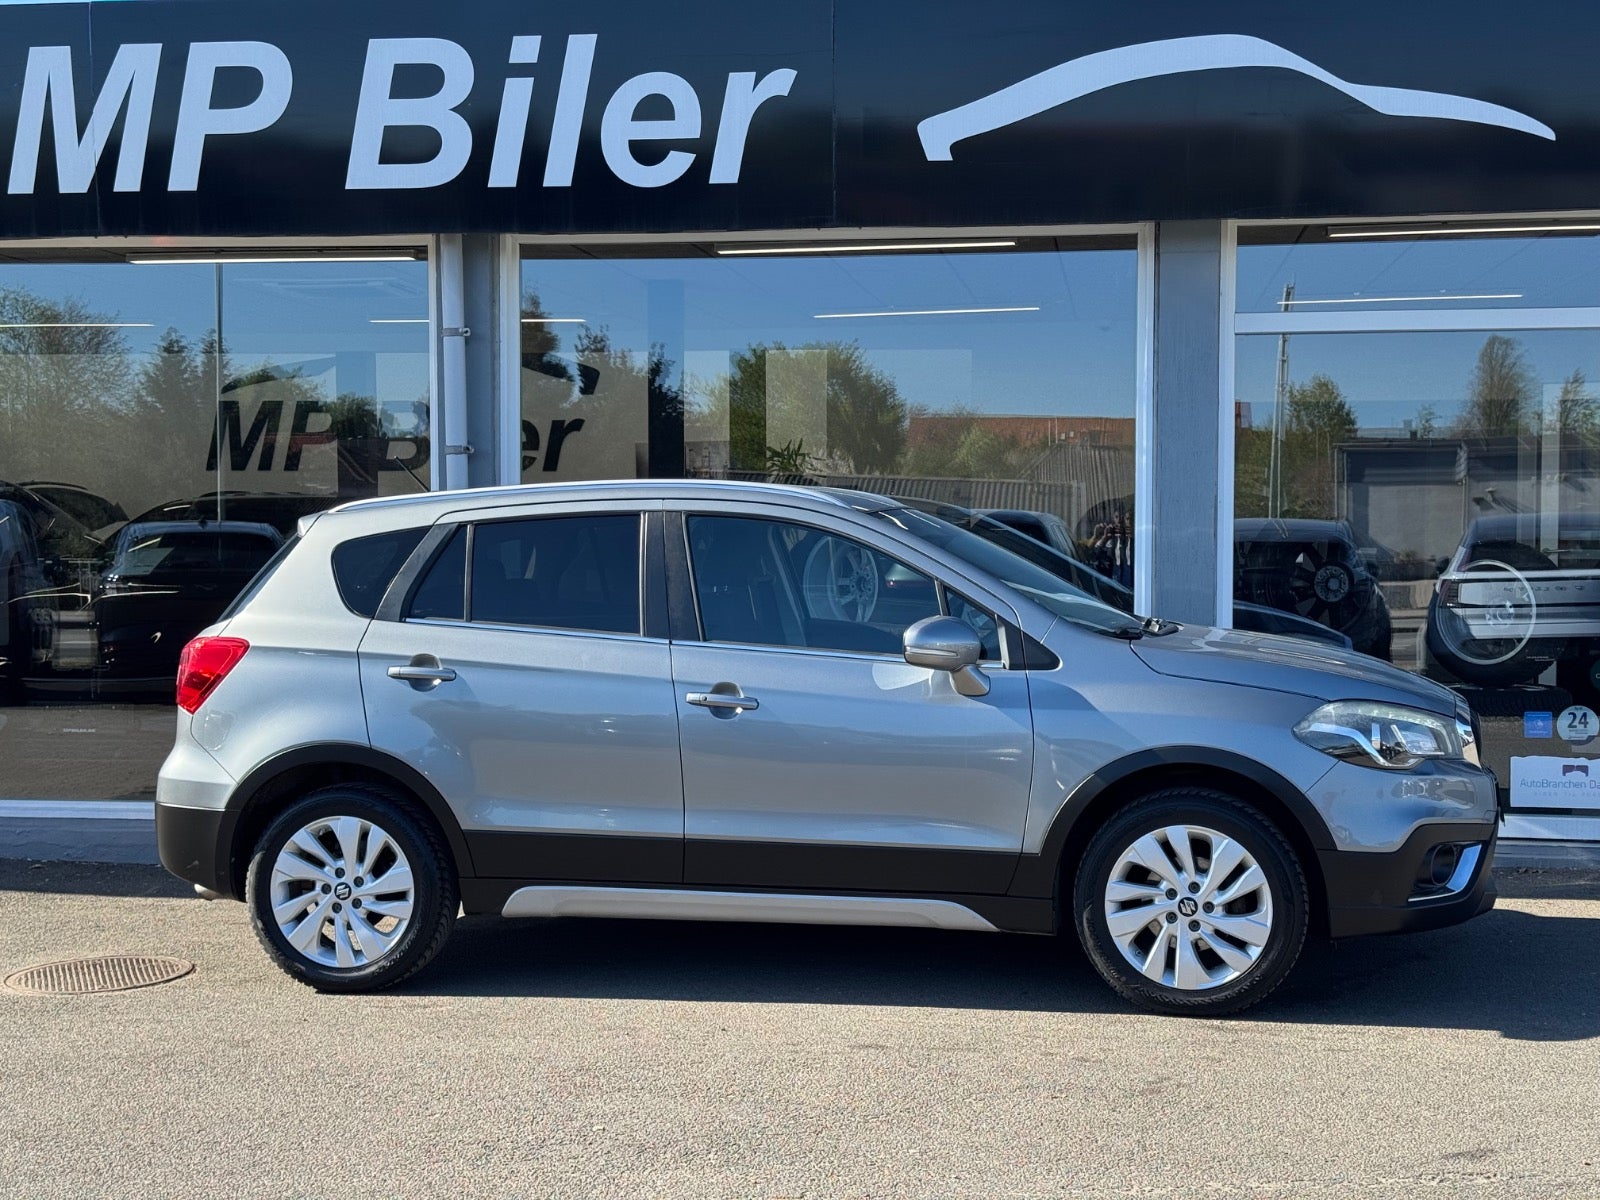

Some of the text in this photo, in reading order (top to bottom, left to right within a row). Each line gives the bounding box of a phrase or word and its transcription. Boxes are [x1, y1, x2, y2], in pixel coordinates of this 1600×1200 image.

[8, 34, 798, 195] MP Biler
[1568, 711, 1589, 729] 24
[1520, 778, 1586, 789] AutoBranchen
